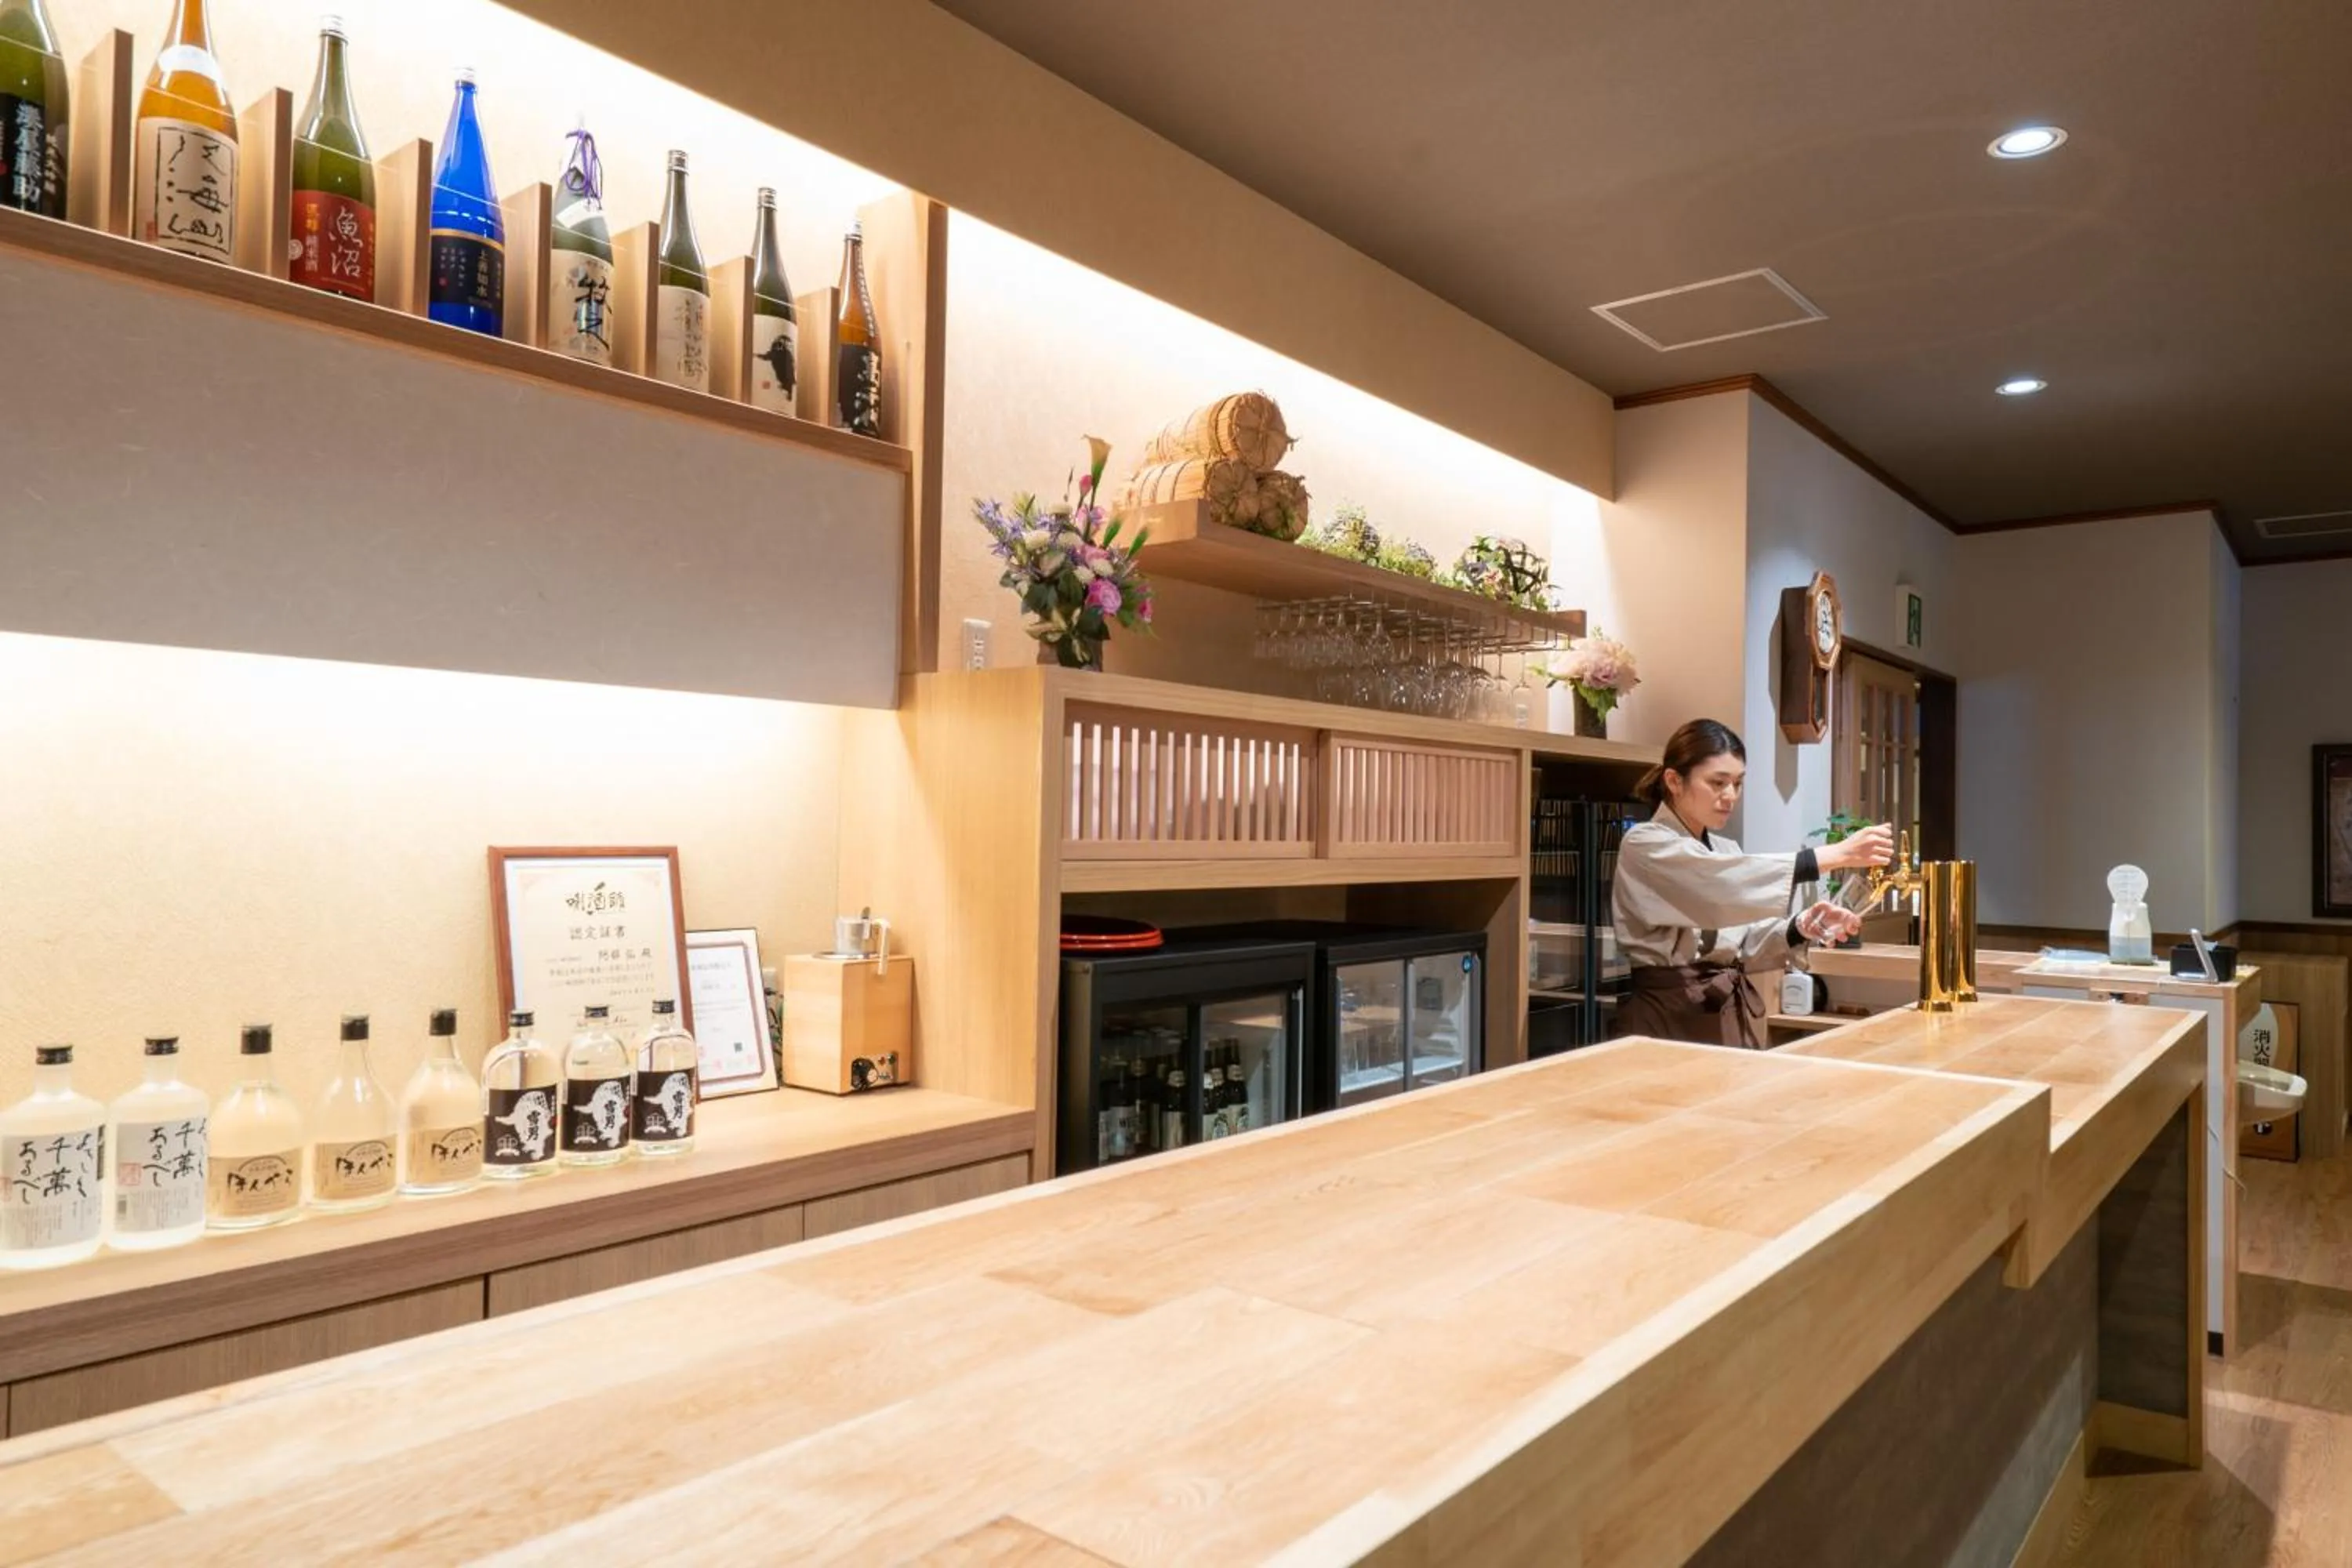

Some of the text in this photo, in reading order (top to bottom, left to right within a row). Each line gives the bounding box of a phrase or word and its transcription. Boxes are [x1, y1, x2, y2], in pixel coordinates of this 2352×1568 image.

[328, 205, 363, 278] 魚沼
[477, 249, 489, 297] 上善如水
[569, 925, 626, 940] 認定証書
[527, 1109, 541, 1142] 雪男
[604, 1099, 617, 1130] 雪男
